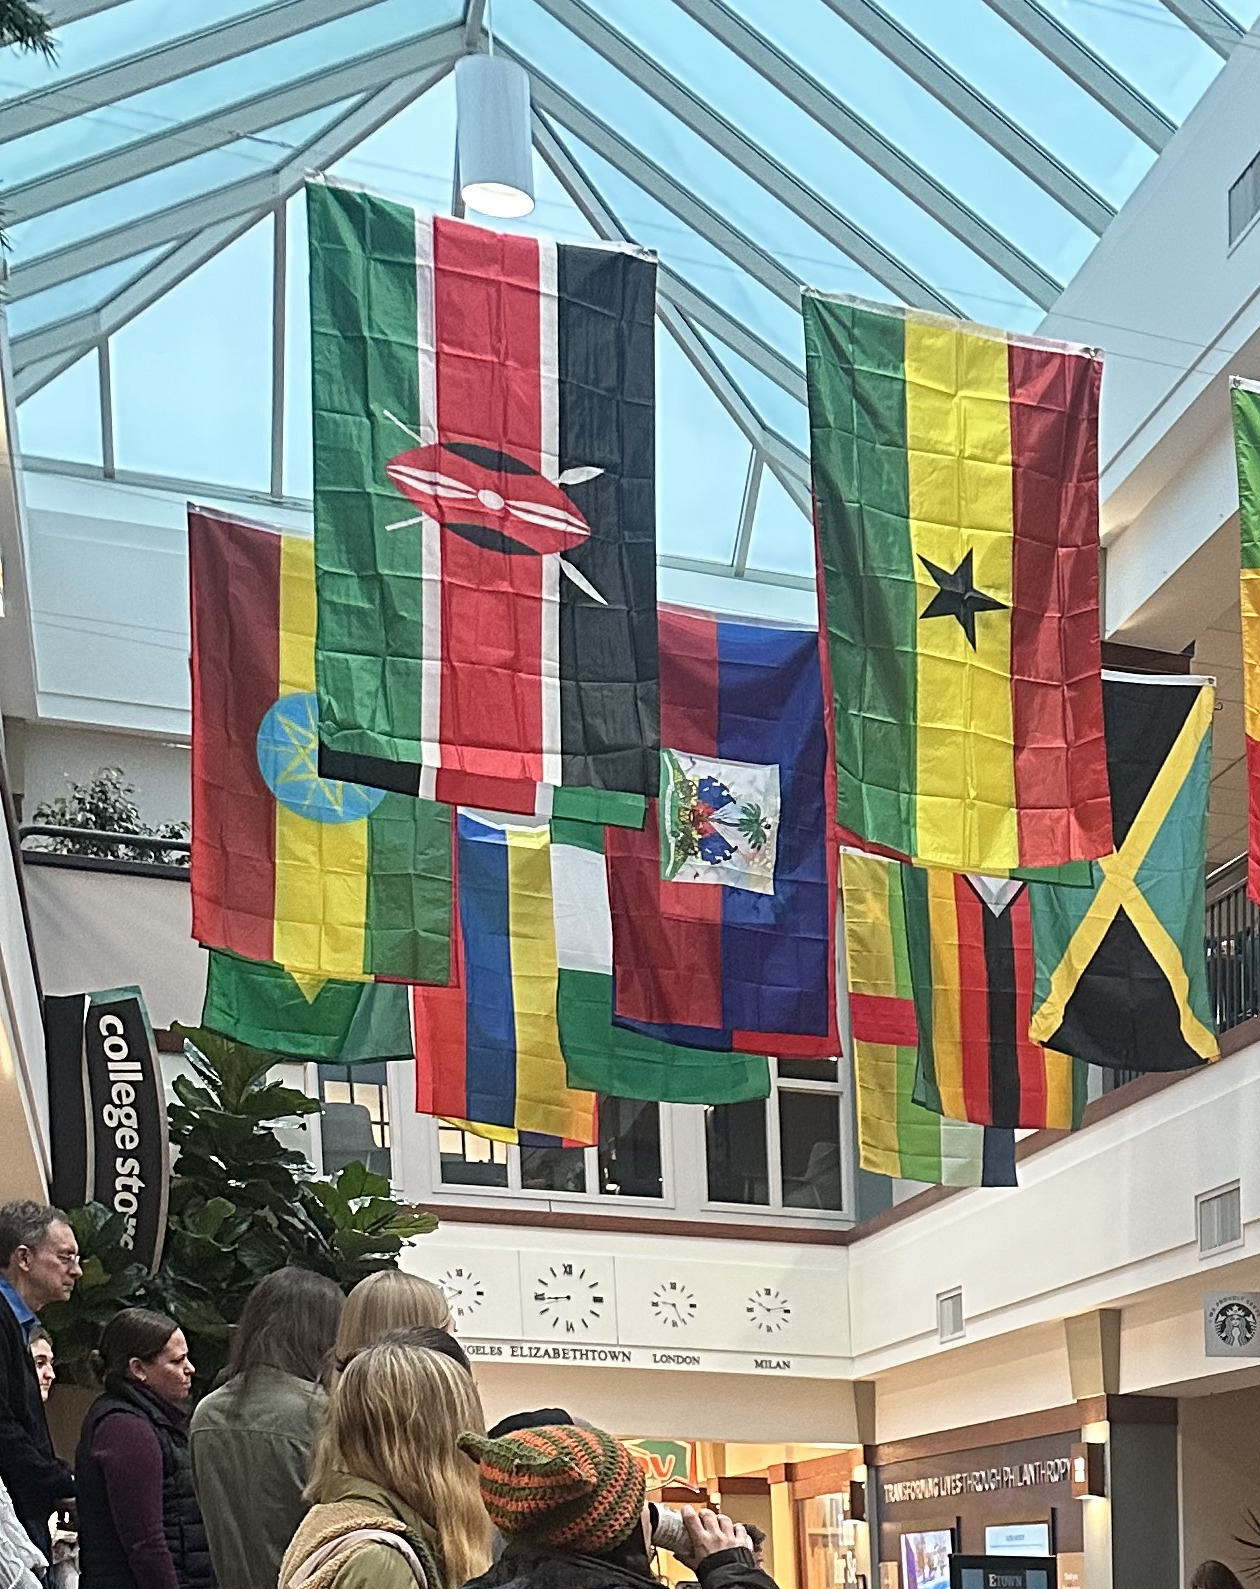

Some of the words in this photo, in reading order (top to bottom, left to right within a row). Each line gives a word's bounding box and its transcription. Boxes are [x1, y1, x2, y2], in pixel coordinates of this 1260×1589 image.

[98, 1014, 143, 1150] college
[463, 1344, 503, 1357] GELES
[510, 1346, 632, 1363] ELIZABETHTOWN
[652, 1353, 701, 1366] LONDON
[754, 1359, 791, 1370] MILAN
[1003, 1457, 1071, 1488] PHILANTHROPY
